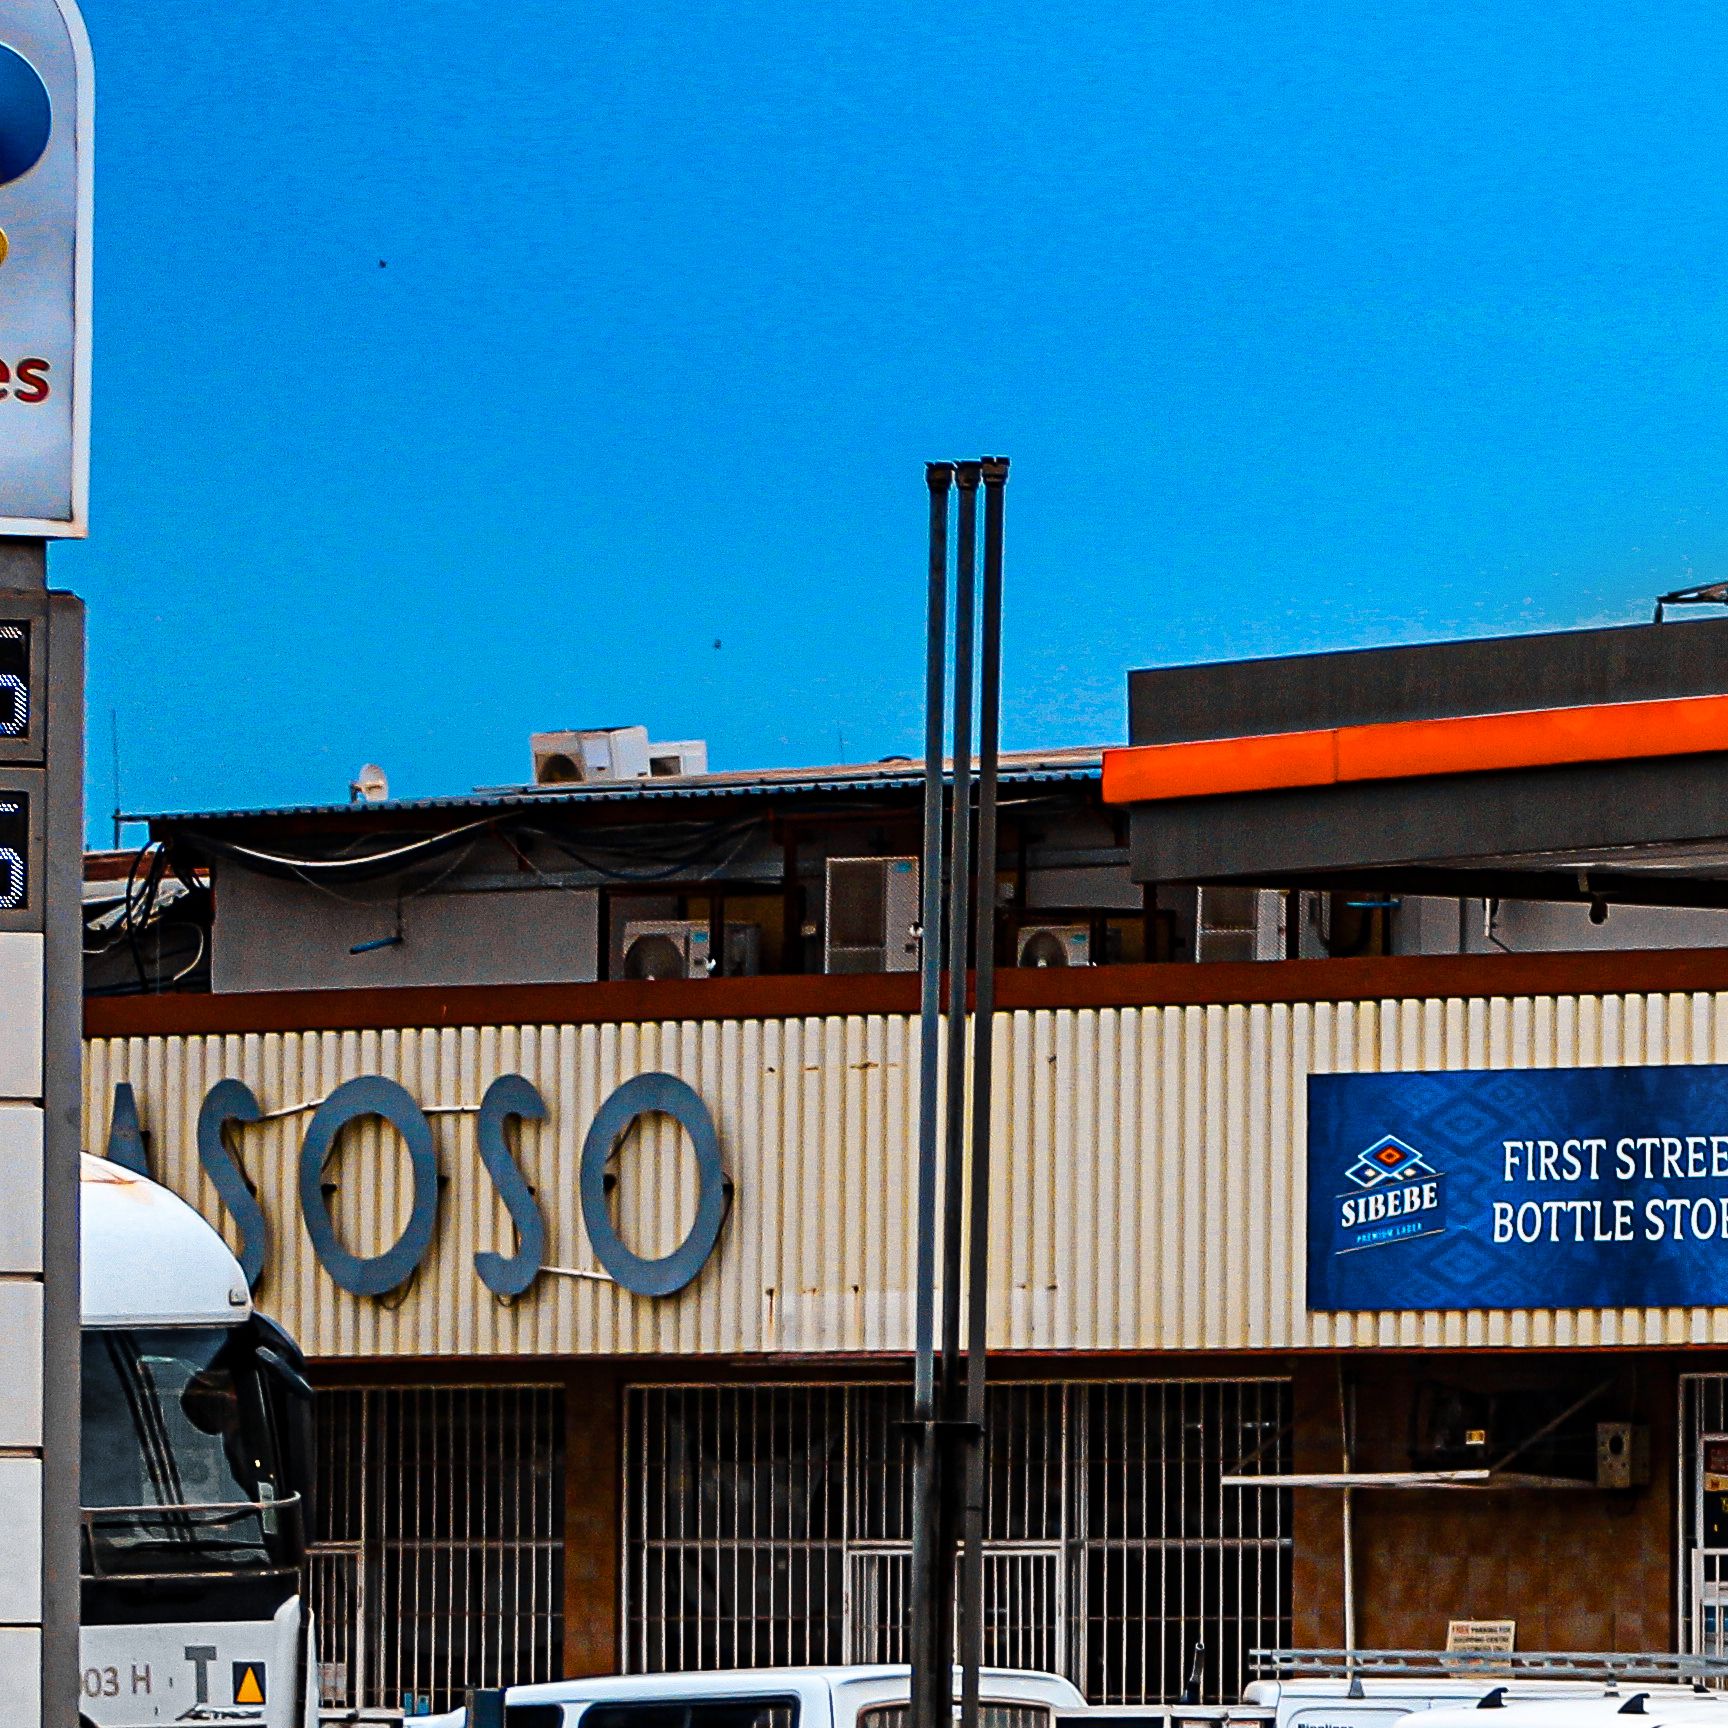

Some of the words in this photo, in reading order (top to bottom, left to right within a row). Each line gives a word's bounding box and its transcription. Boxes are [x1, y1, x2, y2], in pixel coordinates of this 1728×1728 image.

[0, 354, 51, 402] s
[1503, 1139, 1606, 1181] FIRST
[1341, 1182, 1438, 1228] SIBEBE
[1493, 1200, 1634, 1243] BOTTLE
[1356, 1228, 1393, 1244] PREMIUM
[132, 1664, 151, 1694] H
